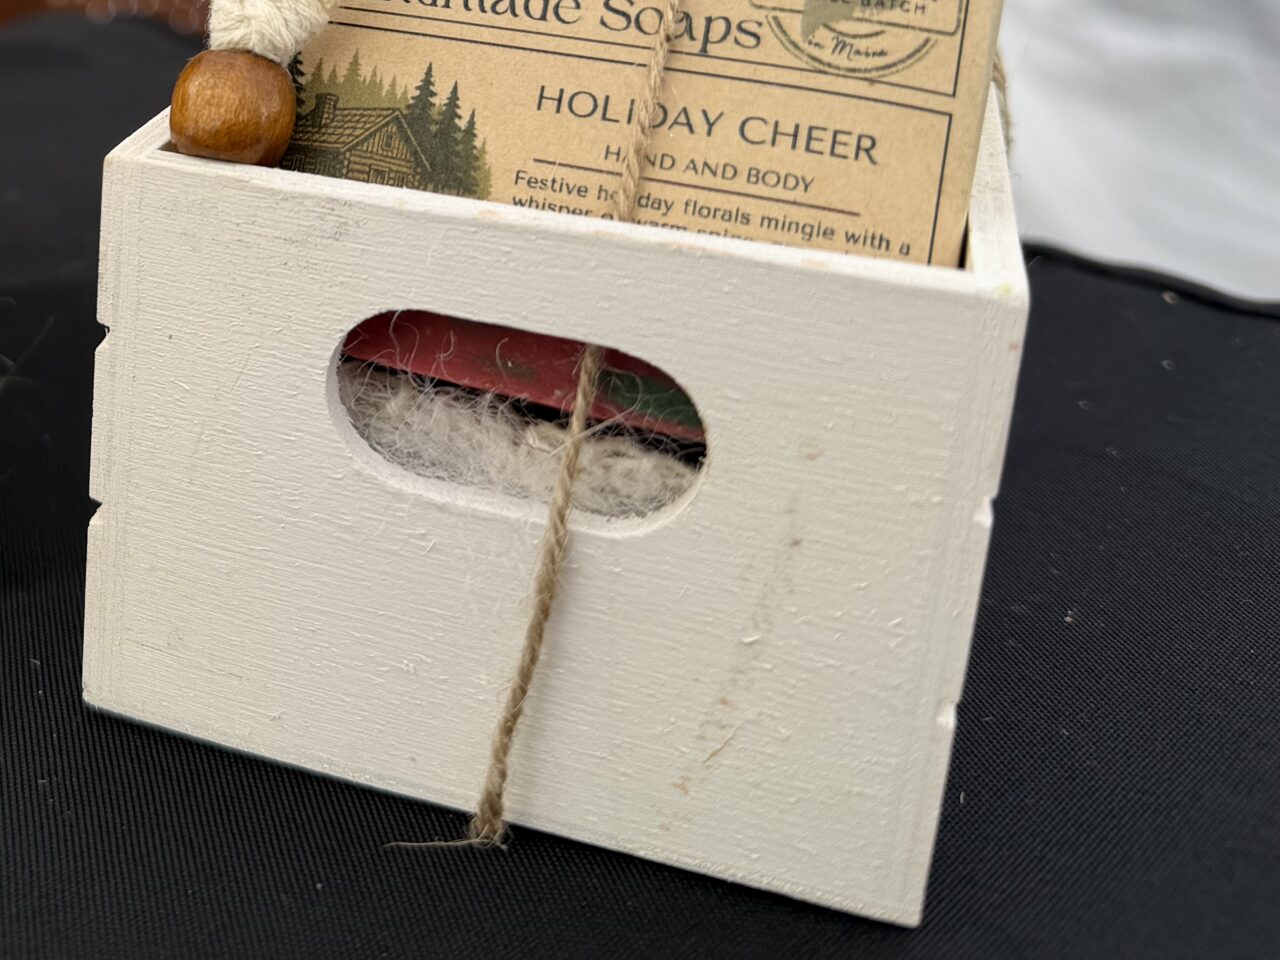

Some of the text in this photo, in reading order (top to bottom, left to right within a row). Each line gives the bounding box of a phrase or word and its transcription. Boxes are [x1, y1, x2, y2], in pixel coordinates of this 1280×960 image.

[739, 116, 879, 165] CHEER
[604, 145, 815, 193] HND AND BODY
[514, 170, 589, 199] Festive
[596, 184, 675, 216] hoday
[684, 198, 752, 226] florals
[760, 214, 836, 241] mingle
[844, 228, 891, 252] with
[898, 242, 912, 257] a
